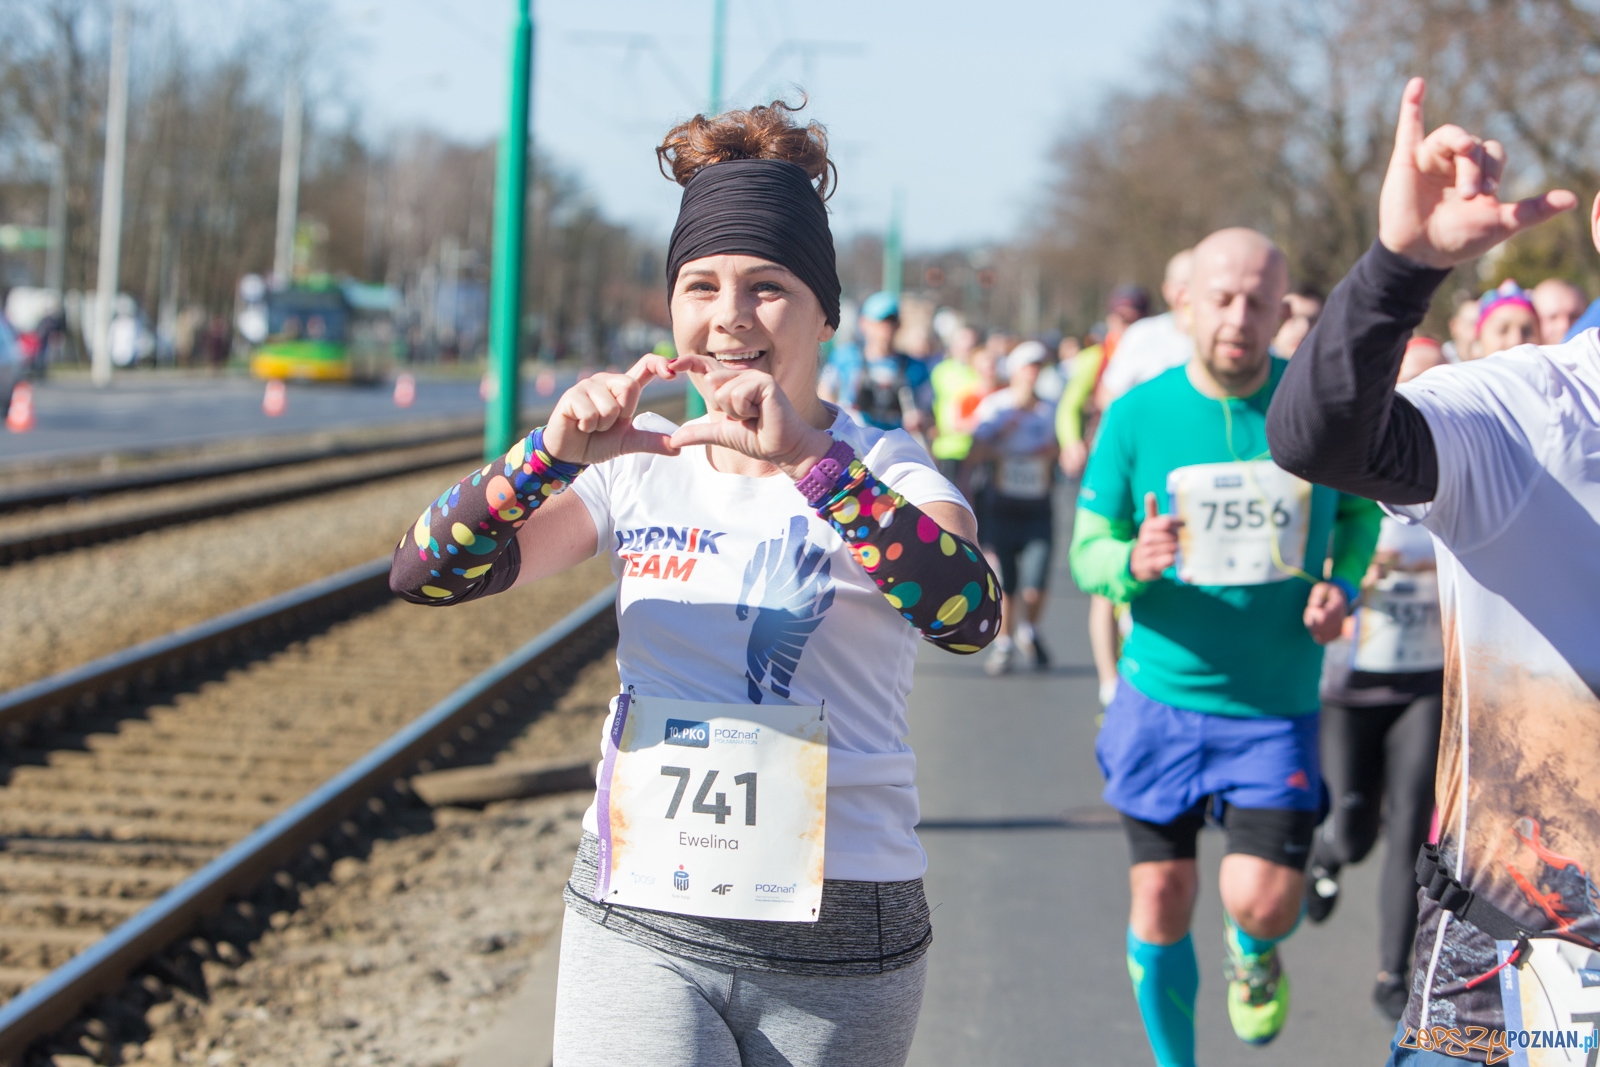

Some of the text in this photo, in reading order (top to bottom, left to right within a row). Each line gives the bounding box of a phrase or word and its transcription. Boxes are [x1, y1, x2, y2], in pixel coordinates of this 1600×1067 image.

[1200, 498, 1291, 531] 7556
[615, 526, 728, 555] HERNIK
[612, 701, 625, 736] 26.03.2017
[682, 728, 706, 741] PKO
[660, 765, 758, 826] 741
[679, 831, 739, 850] Ewelina
